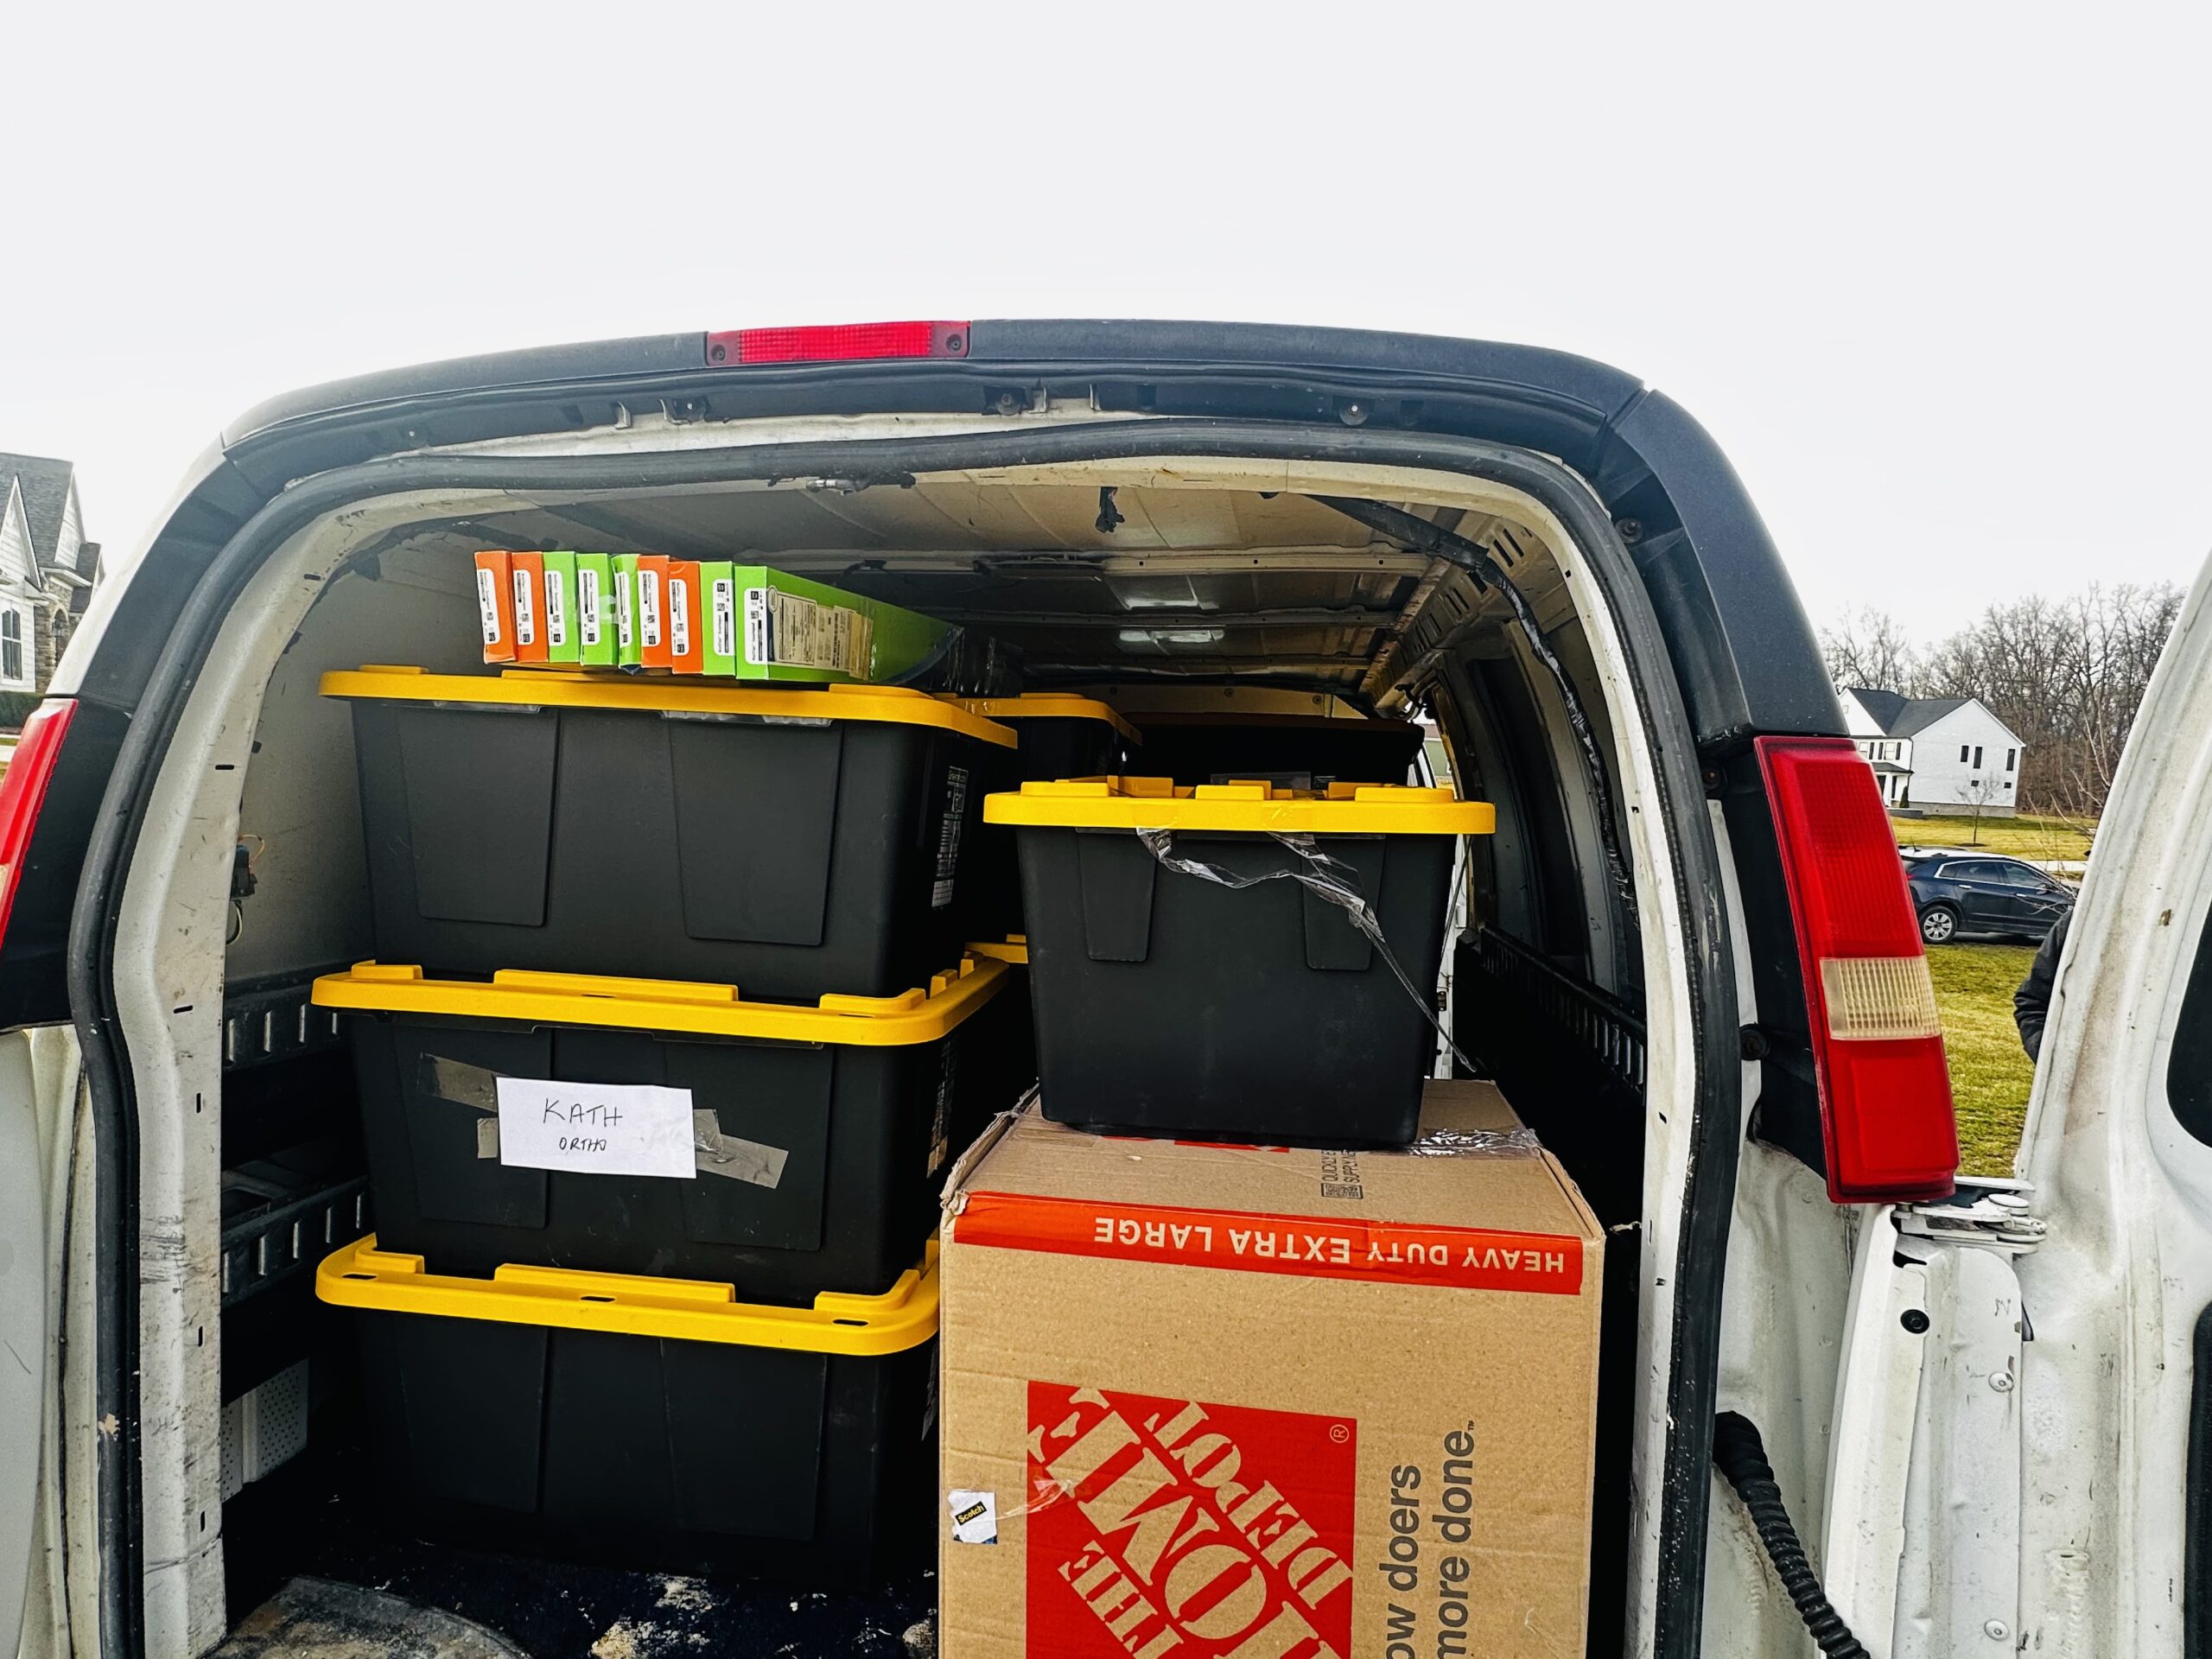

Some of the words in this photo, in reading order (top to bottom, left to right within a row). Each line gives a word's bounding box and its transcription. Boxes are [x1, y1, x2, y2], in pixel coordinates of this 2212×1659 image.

[542, 1097, 623, 1127] KATH
[558, 1136, 607, 1153] ORTHO
[1093, 1217, 1213, 1253] LARGE
[1227, 1228, 1351, 1265] EXTRA
[1366, 1241, 1449, 1267] DUTY
[1461, 1246, 1565, 1274] HEAVY
[957, 1504, 986, 1523] Scotch
[1142, 1401, 1353, 1611] DEPOT
[1378, 1464, 1422, 1592] doers
[1436, 1555, 1471, 1659] more
[1385, 1603, 1417, 1659] ow
